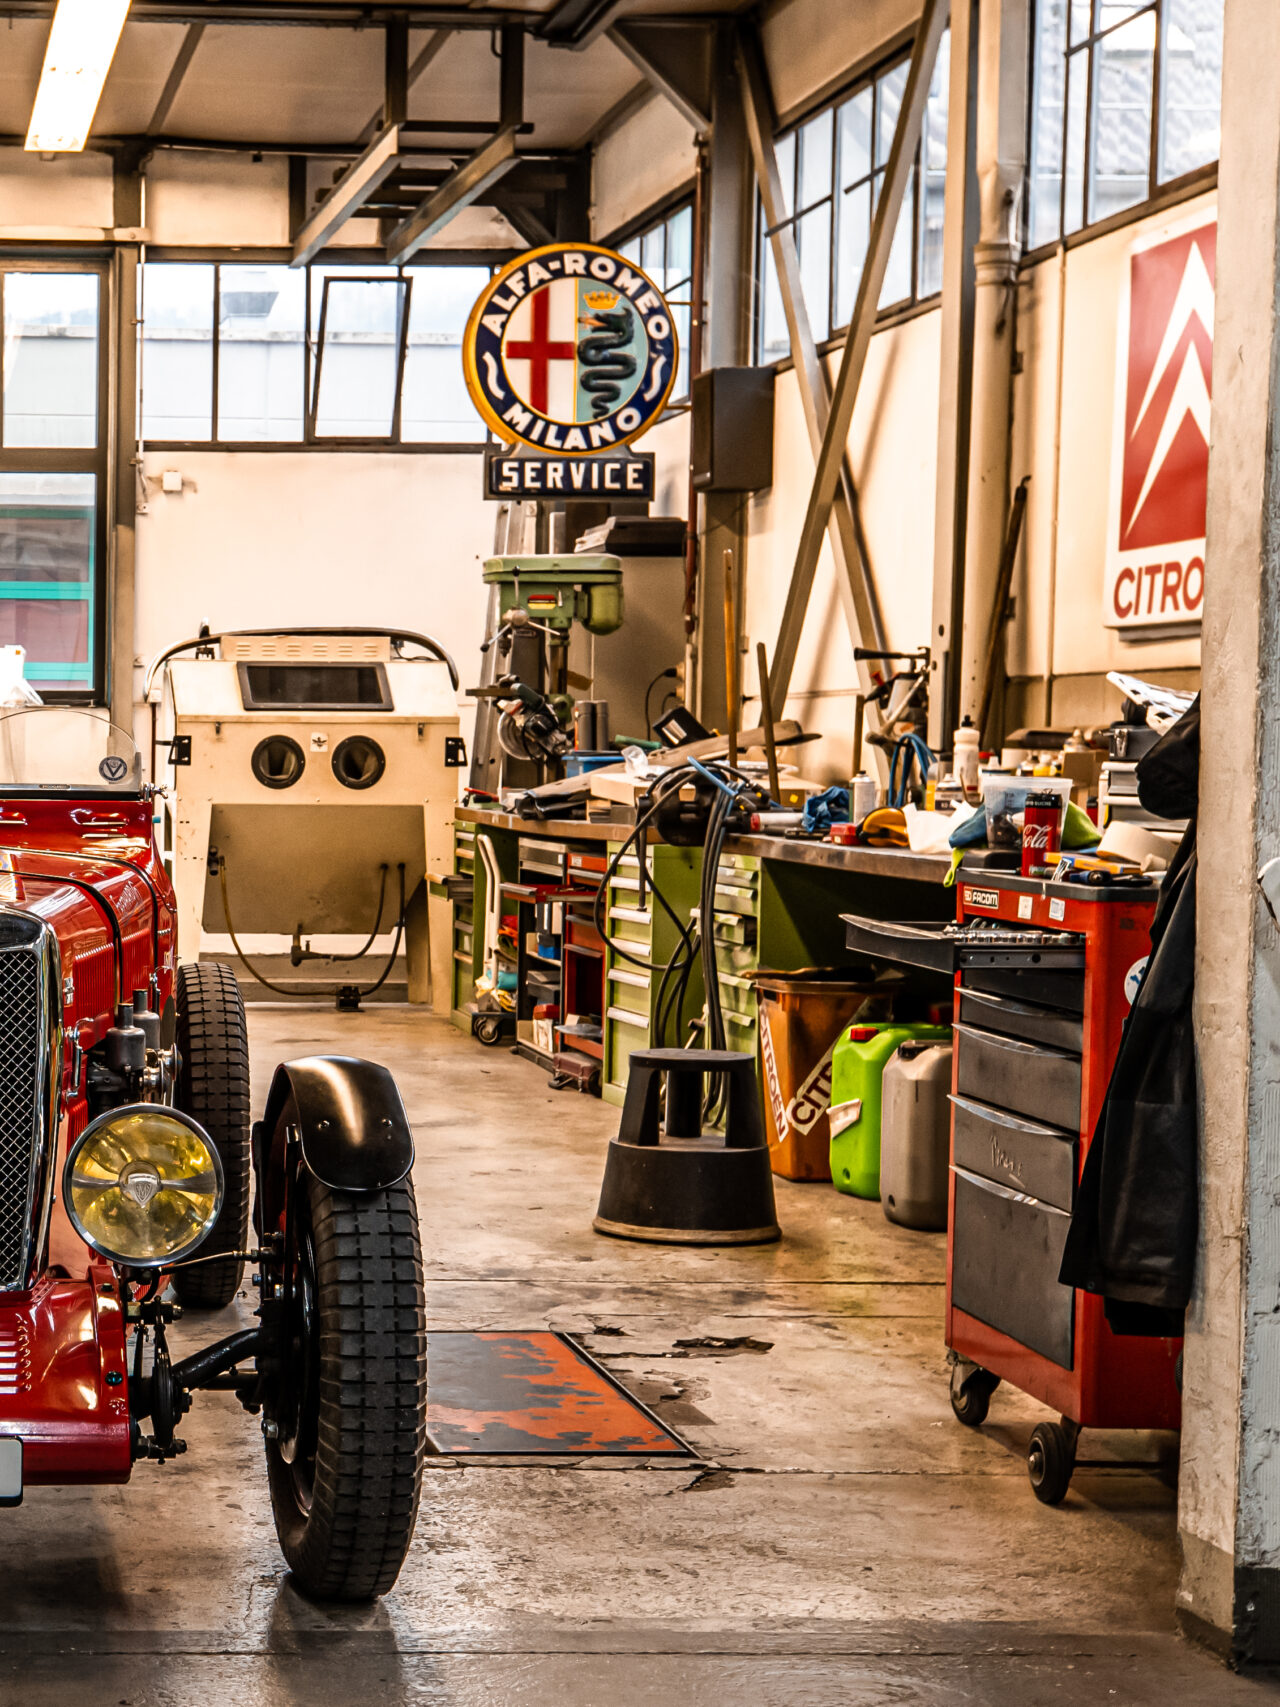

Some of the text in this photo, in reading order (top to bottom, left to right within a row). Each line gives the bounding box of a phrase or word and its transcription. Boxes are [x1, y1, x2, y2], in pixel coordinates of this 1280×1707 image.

[481, 253, 670, 340] ALFA-ROMEO
[502, 403, 642, 449] MILANO
[502, 461, 643, 490] SERVICE
[1113, 556, 1205, 618] CITRO
[1022, 824, 1052, 848] Cola
[972, 891, 998, 906] FACOM
